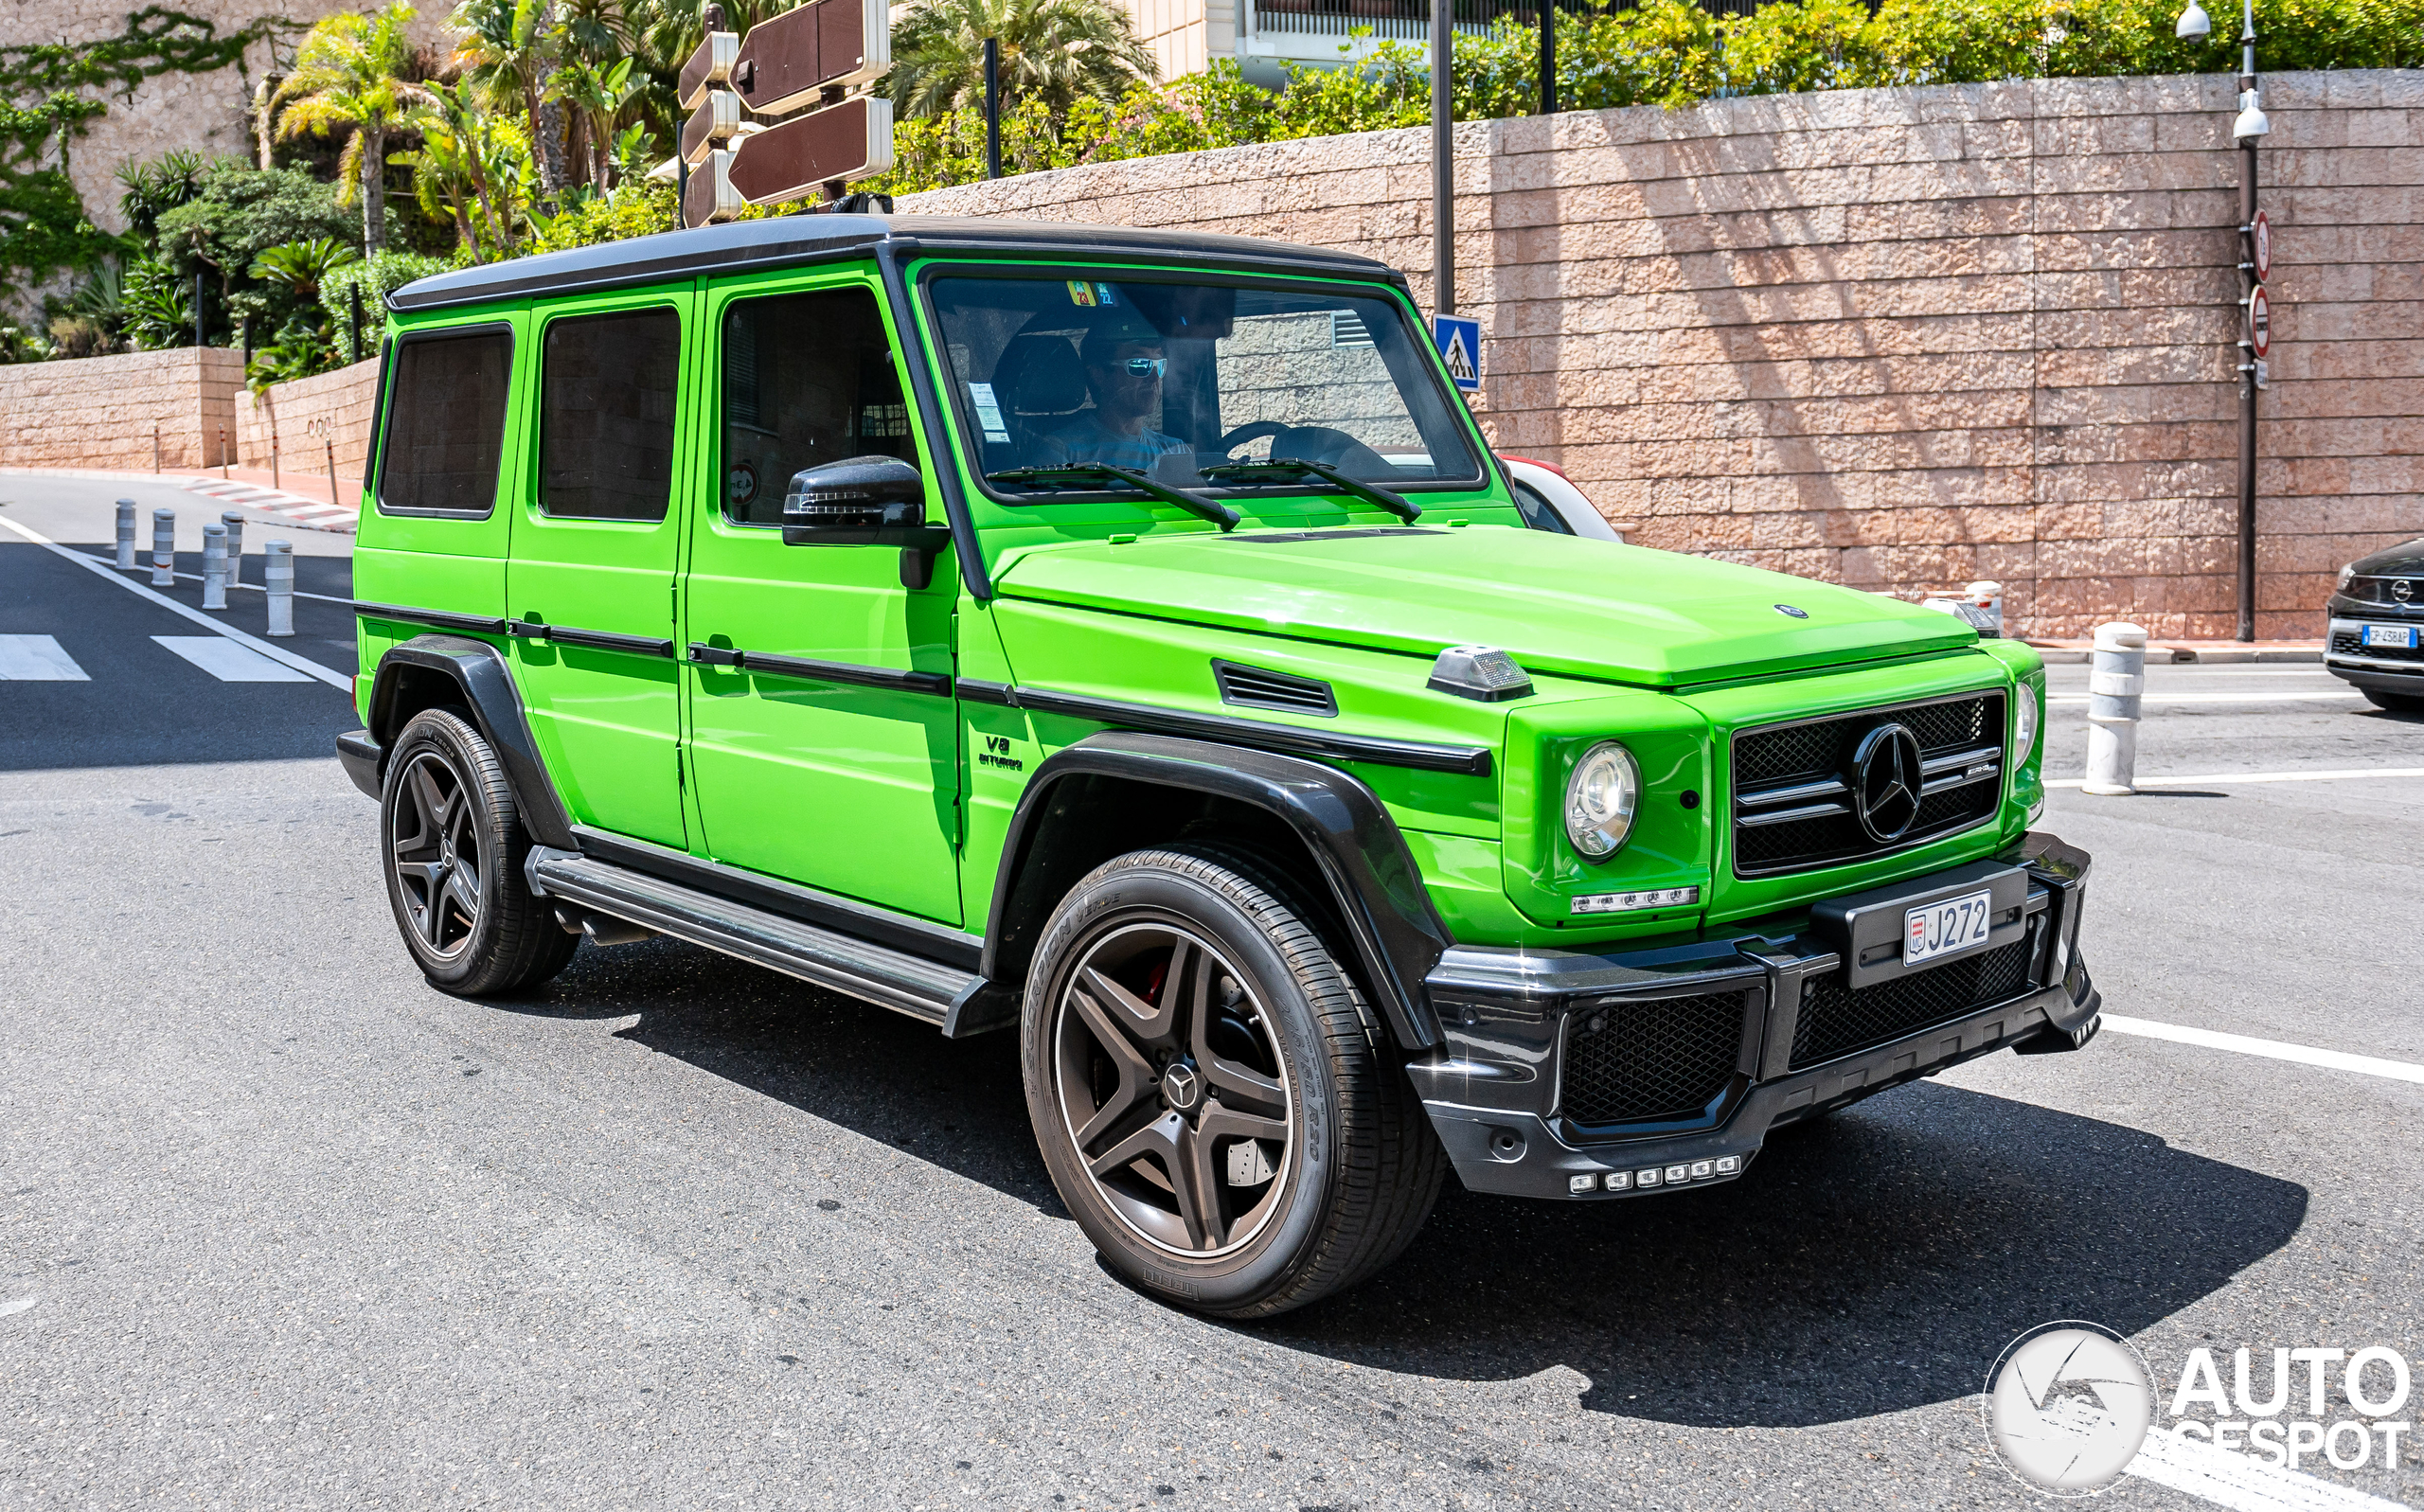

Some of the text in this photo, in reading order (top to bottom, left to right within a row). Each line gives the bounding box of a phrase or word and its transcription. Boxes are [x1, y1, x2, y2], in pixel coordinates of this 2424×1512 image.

[979, 753, 1023, 771] BITURBO
[986, 736, 1010, 754] V8
[1913, 936, 1922, 949] MC
[1929, 899, 1986, 951] J272
[1024, 892, 1121, 1075] SCORPION VERDE
[1309, 1103, 1321, 1163] R20
[1143, 1267, 1200, 1302] PIRELLI
